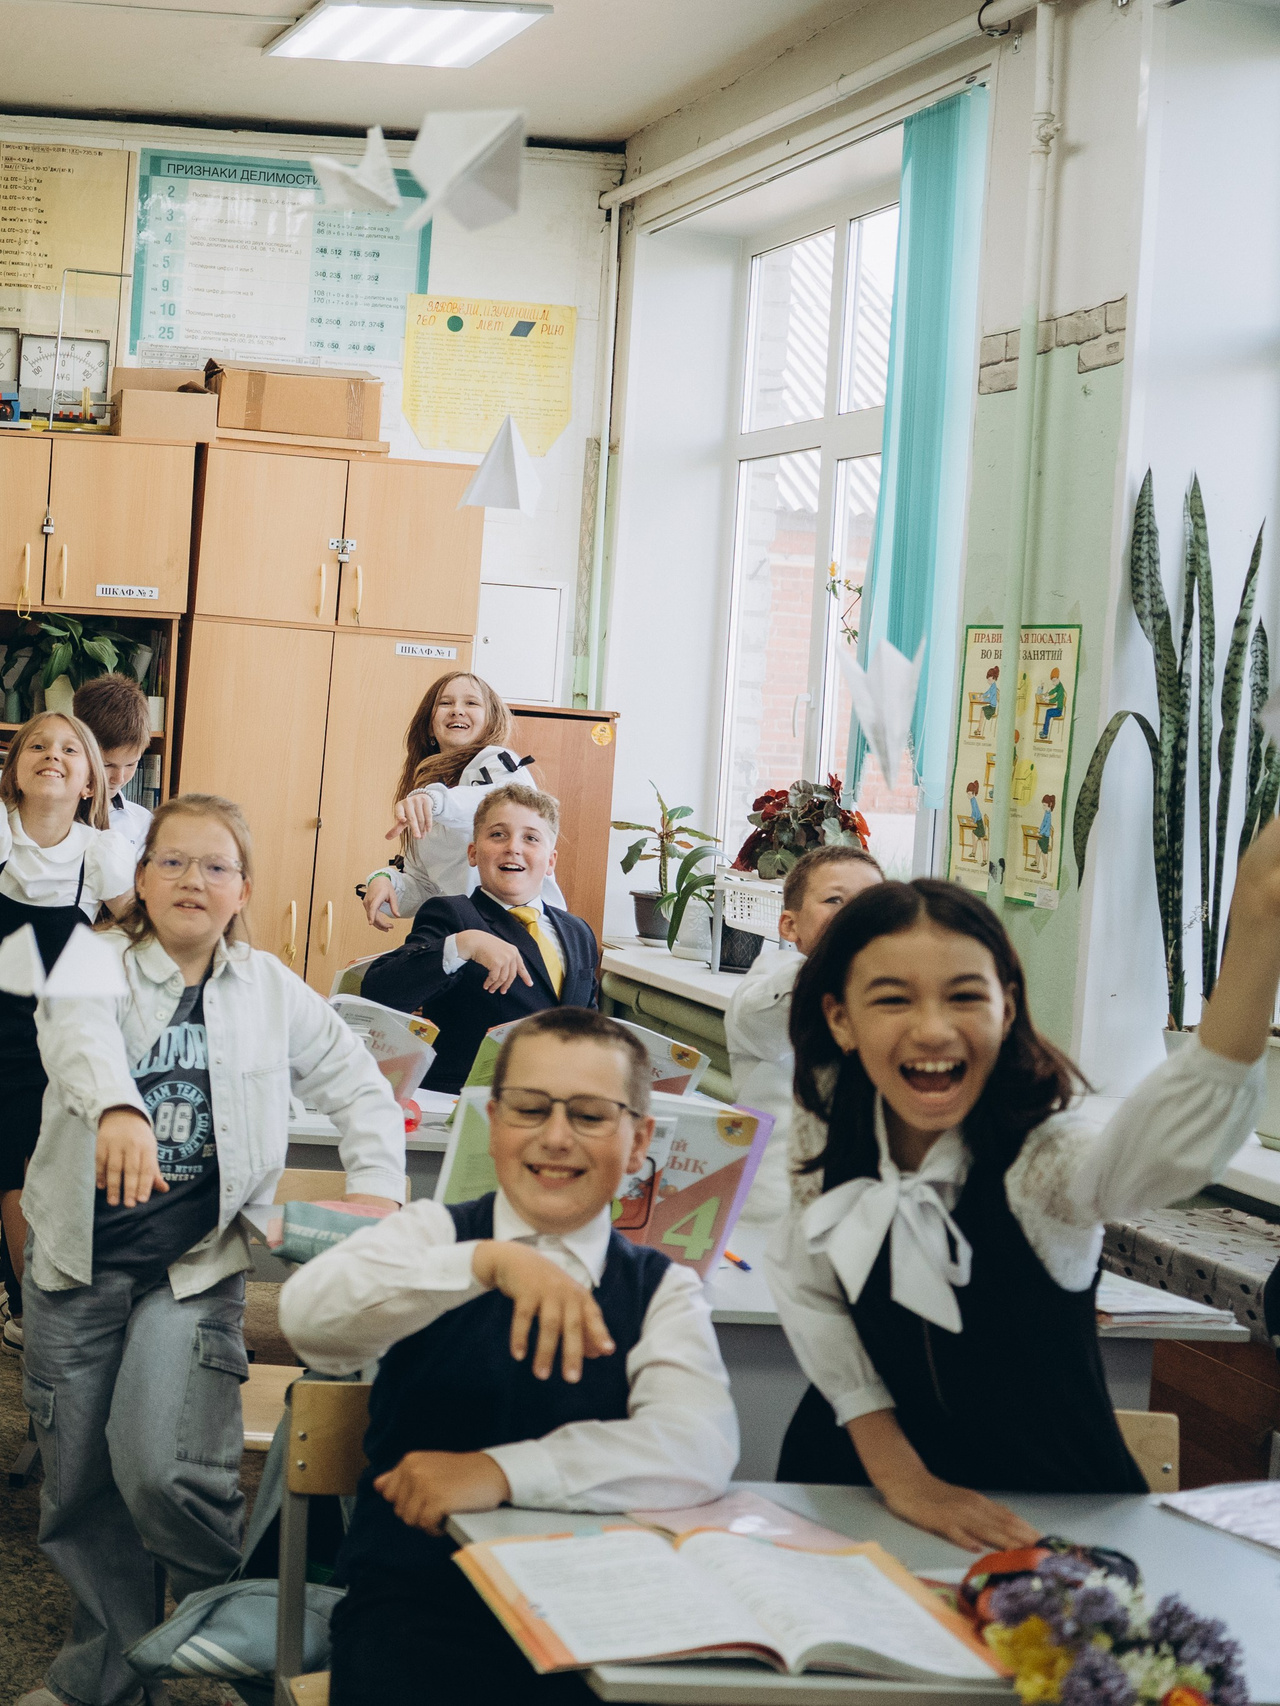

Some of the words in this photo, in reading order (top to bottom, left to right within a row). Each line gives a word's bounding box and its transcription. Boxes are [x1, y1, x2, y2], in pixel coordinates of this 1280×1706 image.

[167, 163, 237, 179] ПРИЗНАКИ
[168, 185, 175, 198] 2
[166, 209, 174, 222] 3
[164, 232, 172, 245] 4
[330, 248, 342, 256] 512
[162, 256, 170, 268] 5
[162, 279, 169, 292] 9
[160, 303, 176, 316] 10
[158, 327, 174, 339] 25
[540, 323, 565, 336] РИЮ
[38, 346, 43, 354] 2
[101, 587, 134, 597] ШКАФ
[148, 590, 154, 598] 2
[1031, 633, 1072, 645] ПОСАДКА
[401, 646, 432, 655] ШКАФ
[981, 650, 992, 659] ВО
[1022, 648, 1063, 660] ЗАНЯТИЙ
[177, 1083, 204, 1107] TEAM
[175, 1164, 203, 1173] NEVER
[661, 1196, 721, 1261] 4
